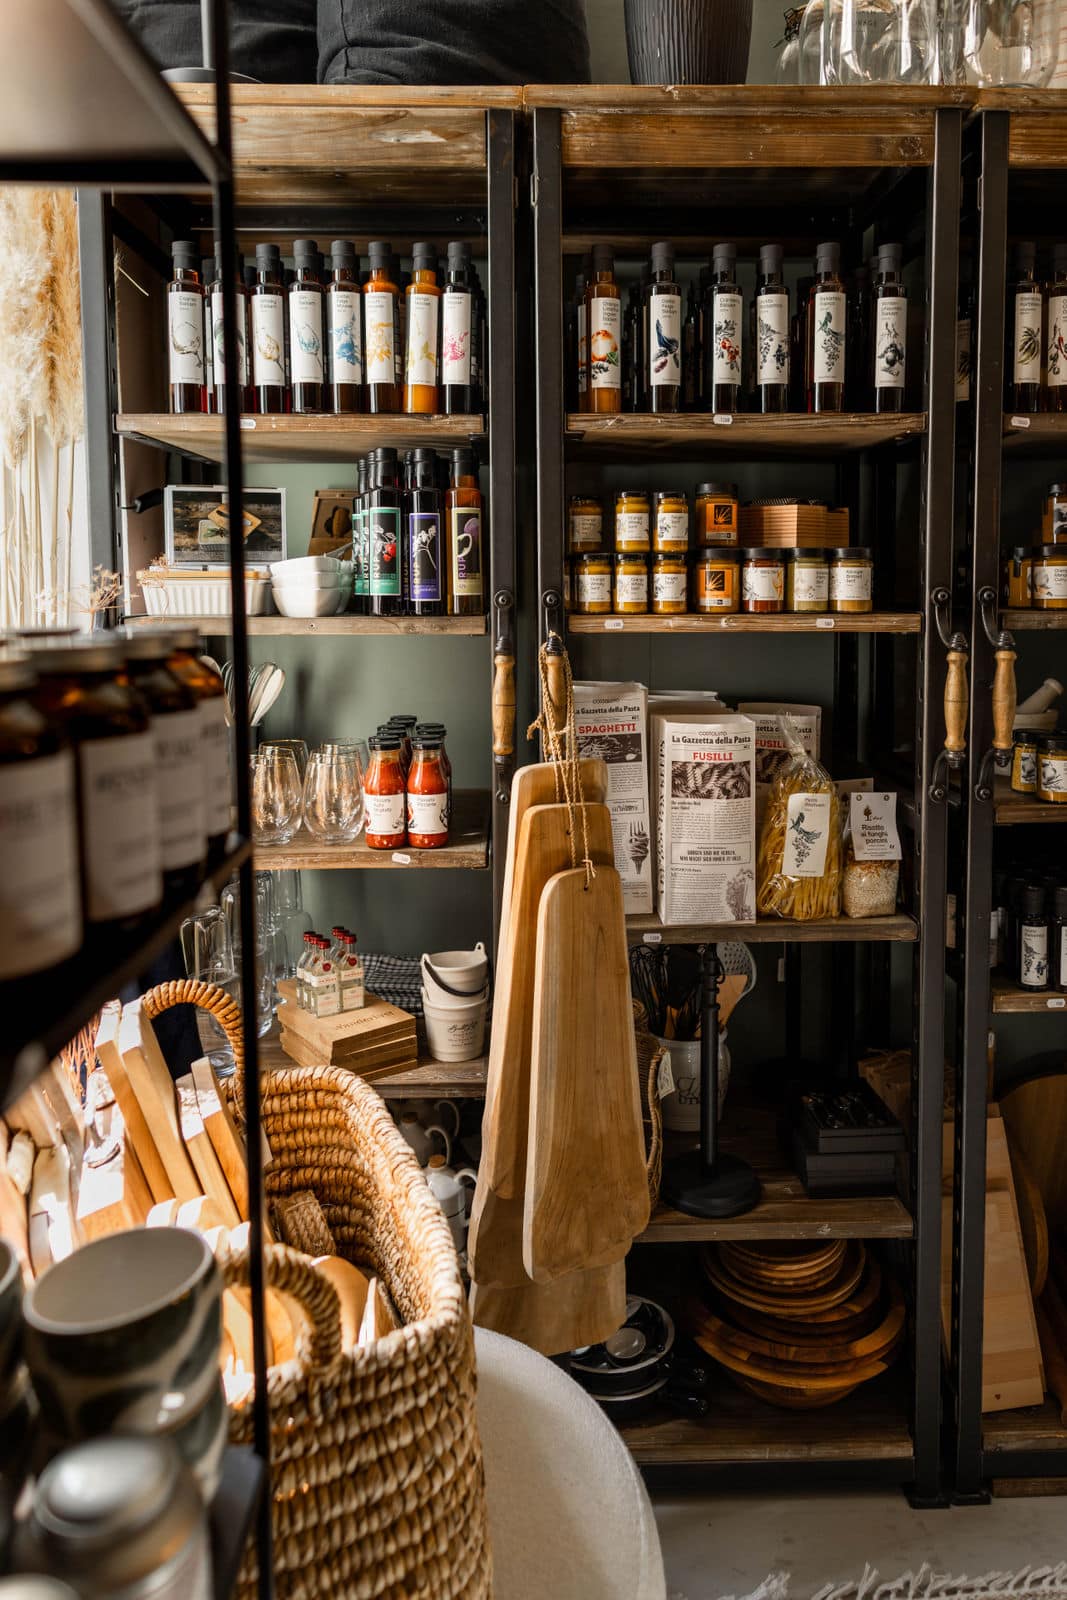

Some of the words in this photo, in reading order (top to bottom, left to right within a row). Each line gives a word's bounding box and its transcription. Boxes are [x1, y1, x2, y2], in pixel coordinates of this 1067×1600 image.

[580, 706, 607, 714] Gazzetta
[578, 722, 637, 734] SPAGHETTI
[672, 735, 681, 743] La
[681, 735, 714, 744] Gazzetta
[714, 736, 732, 744] della
[733, 735, 751, 744] Pasta
[755, 739, 786, 749] FUSIL
[693, 751, 733, 761] FUSILLI
